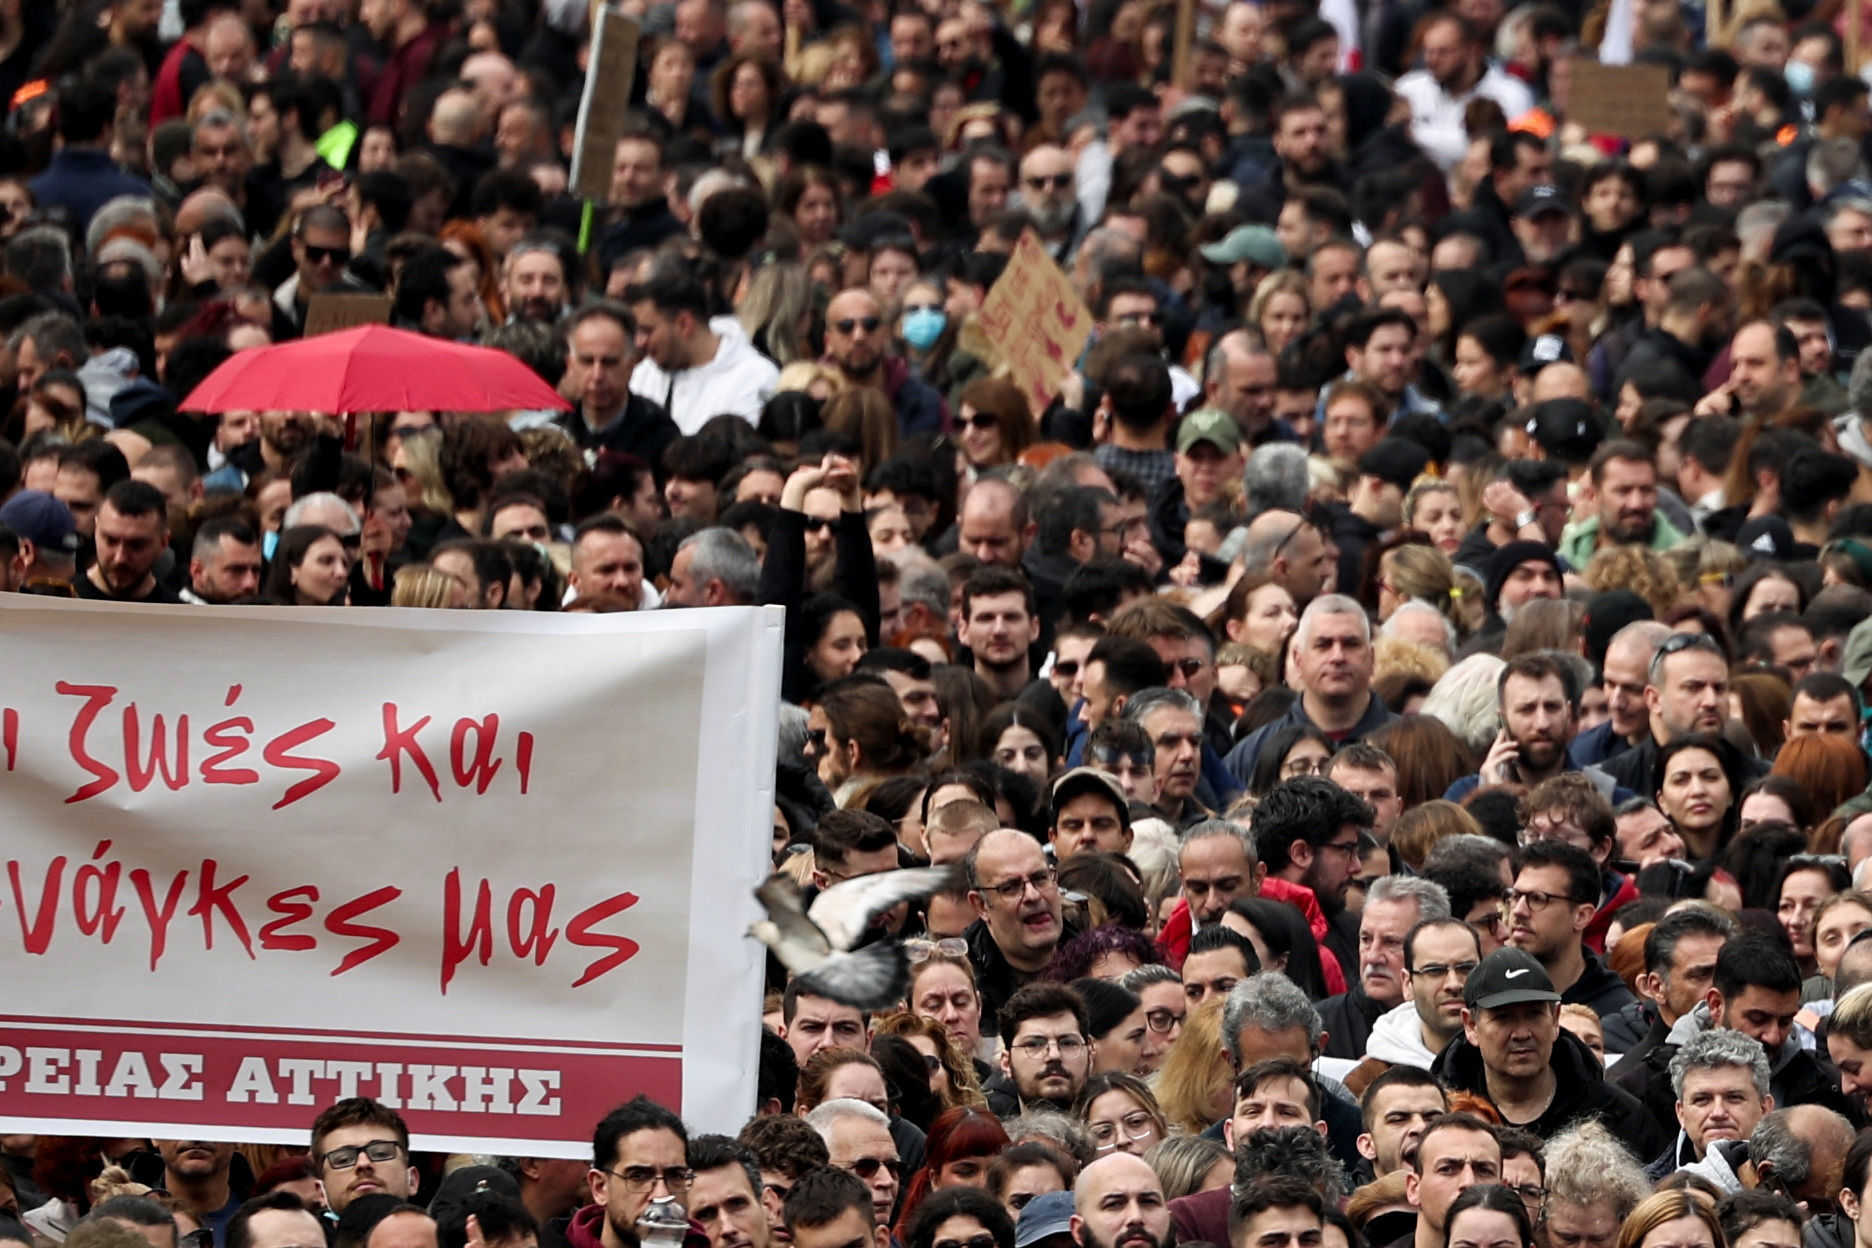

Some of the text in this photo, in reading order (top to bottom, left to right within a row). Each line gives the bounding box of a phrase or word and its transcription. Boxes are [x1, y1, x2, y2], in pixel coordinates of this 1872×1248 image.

[55, 680, 342, 811] ζωές
[375, 701, 535, 803] και
[0, 838, 641, 997] νάγκες μας
[226, 1055, 562, 1117] ΑΤΤΙΚΗΣ
